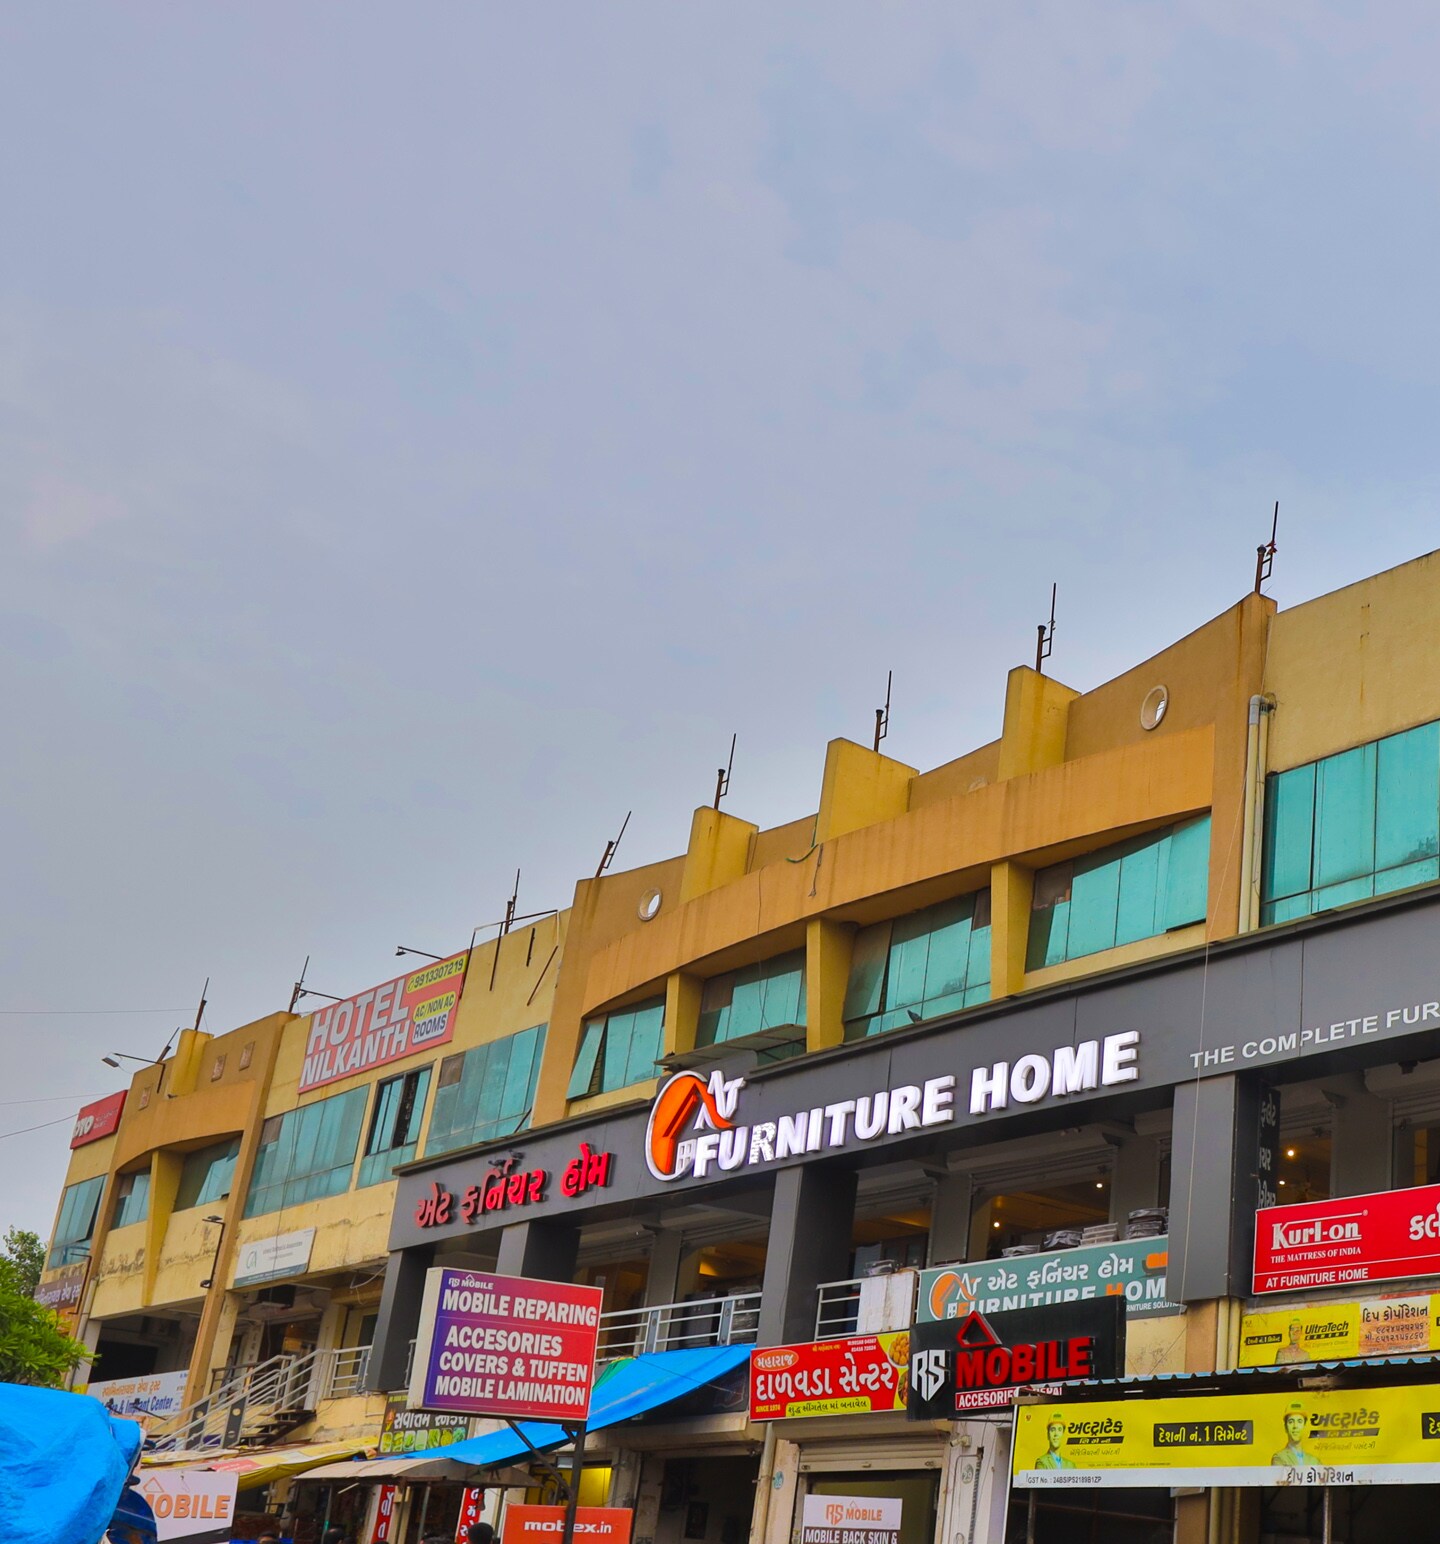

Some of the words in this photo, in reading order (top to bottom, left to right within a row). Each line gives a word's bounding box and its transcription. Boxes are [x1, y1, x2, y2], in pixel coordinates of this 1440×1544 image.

[306, 978, 409, 1056] HOTEL
[413, 1014, 447, 1039] ROOMS
[299, 1020, 411, 1088] NILKANTH
[415, 999, 443, 1019] AC/NON
[443, 994, 455, 1008] AC
[1189, 1044, 1236, 1070] THE
[1242, 1015, 1380, 1059] COMPLETE
[692, 1074, 957, 1178] FURNITURE
[969, 1029, 1141, 1116] HOME
[415, 1182, 453, 1228] એટ
[560, 1142, 612, 1197] હોમ
[1271, 1216, 1362, 1250] Kurl-on
[1270, 1254, 1286, 1265] THE
[1287, 1249, 1327, 1263] MATTRESS
[1328, 1247, 1338, 1258] OF
[1339, 1246, 1362, 1258] INDIA
[461, 1279, 494, 1290] MOBILE
[987, 1269, 1019, 1292] એટ
[1098, 1253, 1134, 1279] હોમ
[1265, 1276, 1280, 1288] AT
[1281, 1271, 1335, 1288] FURNITURE
[1338, 1267, 1369, 1281] HOME
[1106, 1278, 1166, 1302] HOM
[442, 1289, 511, 1316] MOBILE
[513, 1298, 597, 1327] REPARING
[444, 1325, 563, 1358] ACCESORIES
[1304, 1320, 1349, 1335] UltraTech
[439, 1351, 507, 1375] COVERS
[512, 1358, 525, 1376] &
[529, 1359, 588, 1383] TUFFEN
[756, 1353, 794, 1368] મહારાજ
[955, 1336, 1092, 1390] MOBILE
[434, 1375, 494, 1399] MOBILE
[497, 1380, 586, 1406] LAMINATION
[756, 1367, 833, 1401] દાળવડા
[838, 1352, 894, 1393] સેન્ટર
[150, 1396, 173, 1412] Center
[1158, 1426, 1186, 1443] દેશની
[1214, 1426, 1249, 1442] સિમેન્ટ
[846, 1508, 882, 1521] MOBILE
[805, 1529, 840, 1544] MOBILE
[842, 1529, 866, 1544] BACK
[868, 1531, 890, 1544] SKIN
[892, 1532, 898, 1544] &
